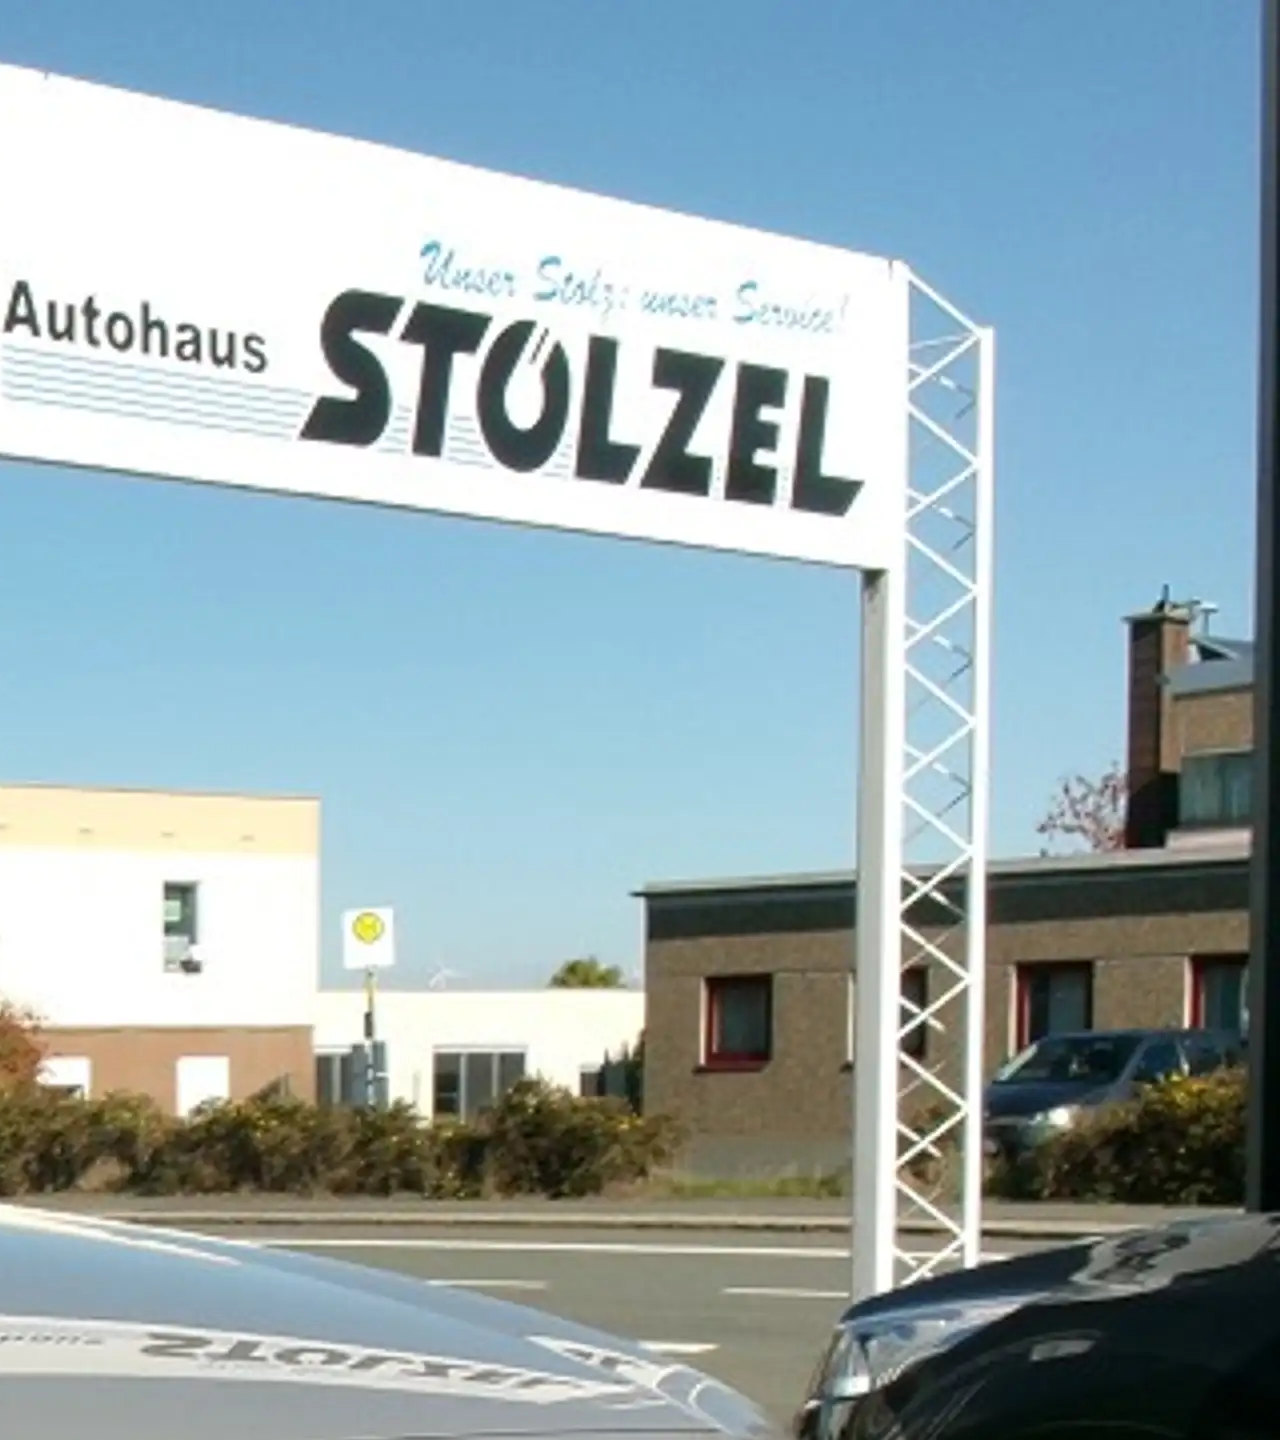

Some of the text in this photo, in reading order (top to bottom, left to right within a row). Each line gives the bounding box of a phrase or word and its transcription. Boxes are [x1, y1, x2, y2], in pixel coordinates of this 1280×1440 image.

[420, 240, 516, 298] Unser
[641, 287, 718, 322] unser
[2, 279, 269, 374] Autohaus
